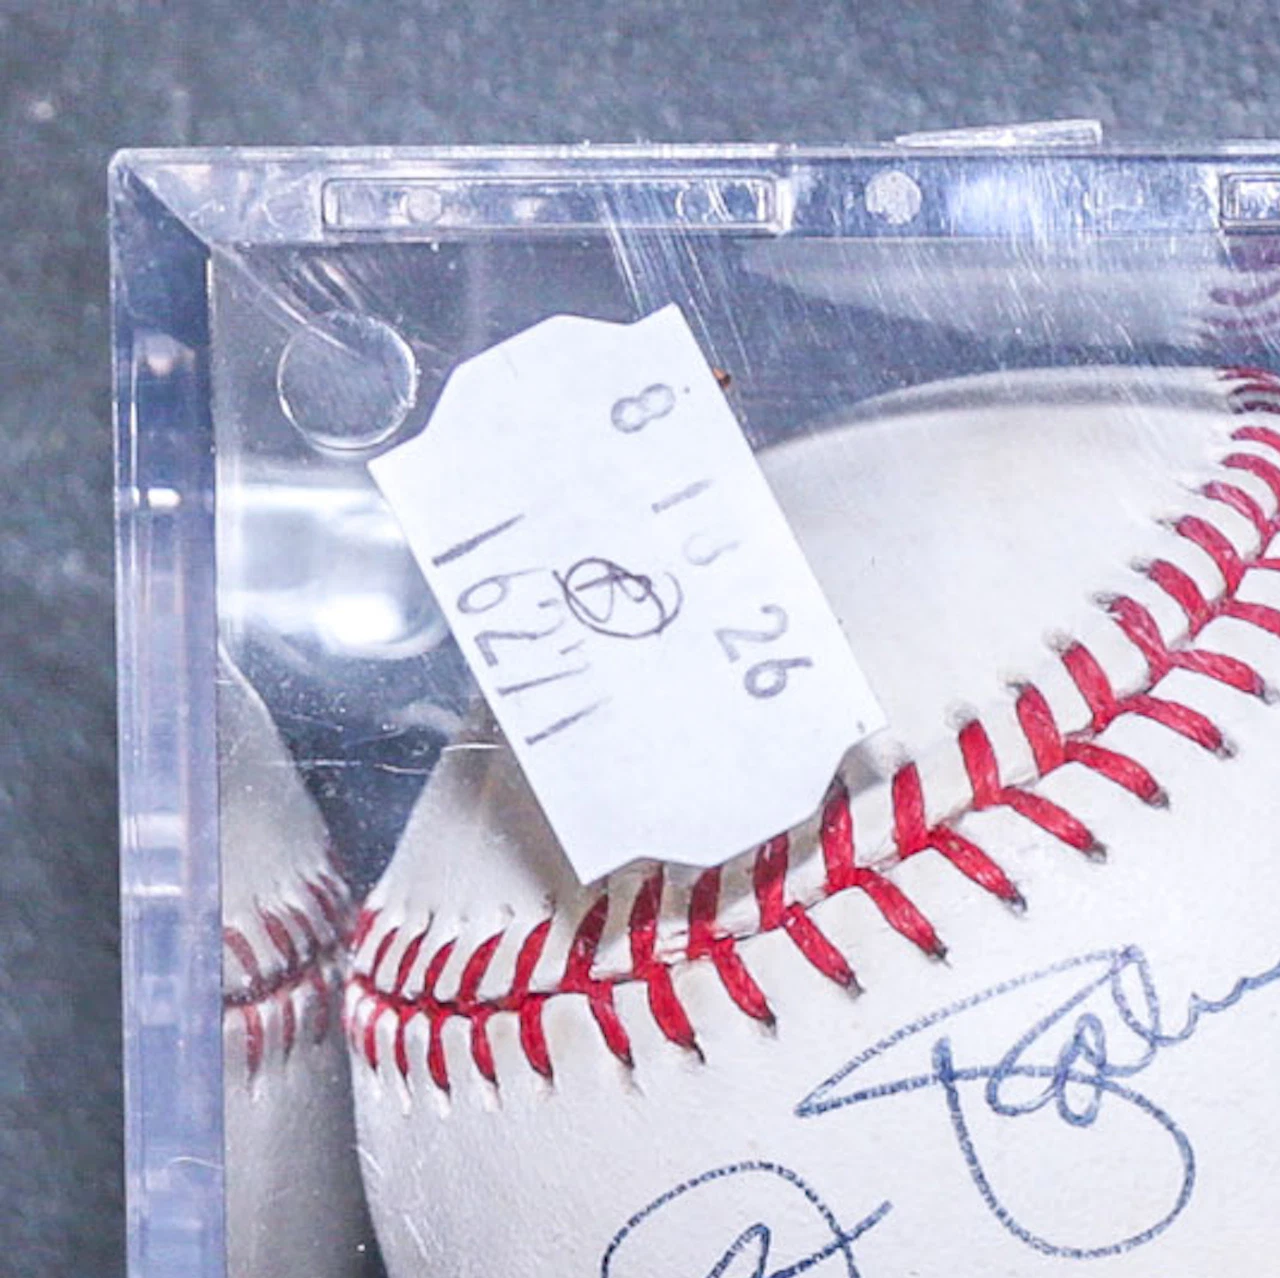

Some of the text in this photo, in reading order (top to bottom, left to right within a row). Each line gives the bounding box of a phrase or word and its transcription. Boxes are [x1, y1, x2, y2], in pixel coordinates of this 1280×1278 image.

[431, 513, 614, 746] 16271
[609, 382, 676, 434] 8
[714, 604, 815, 699] 26
